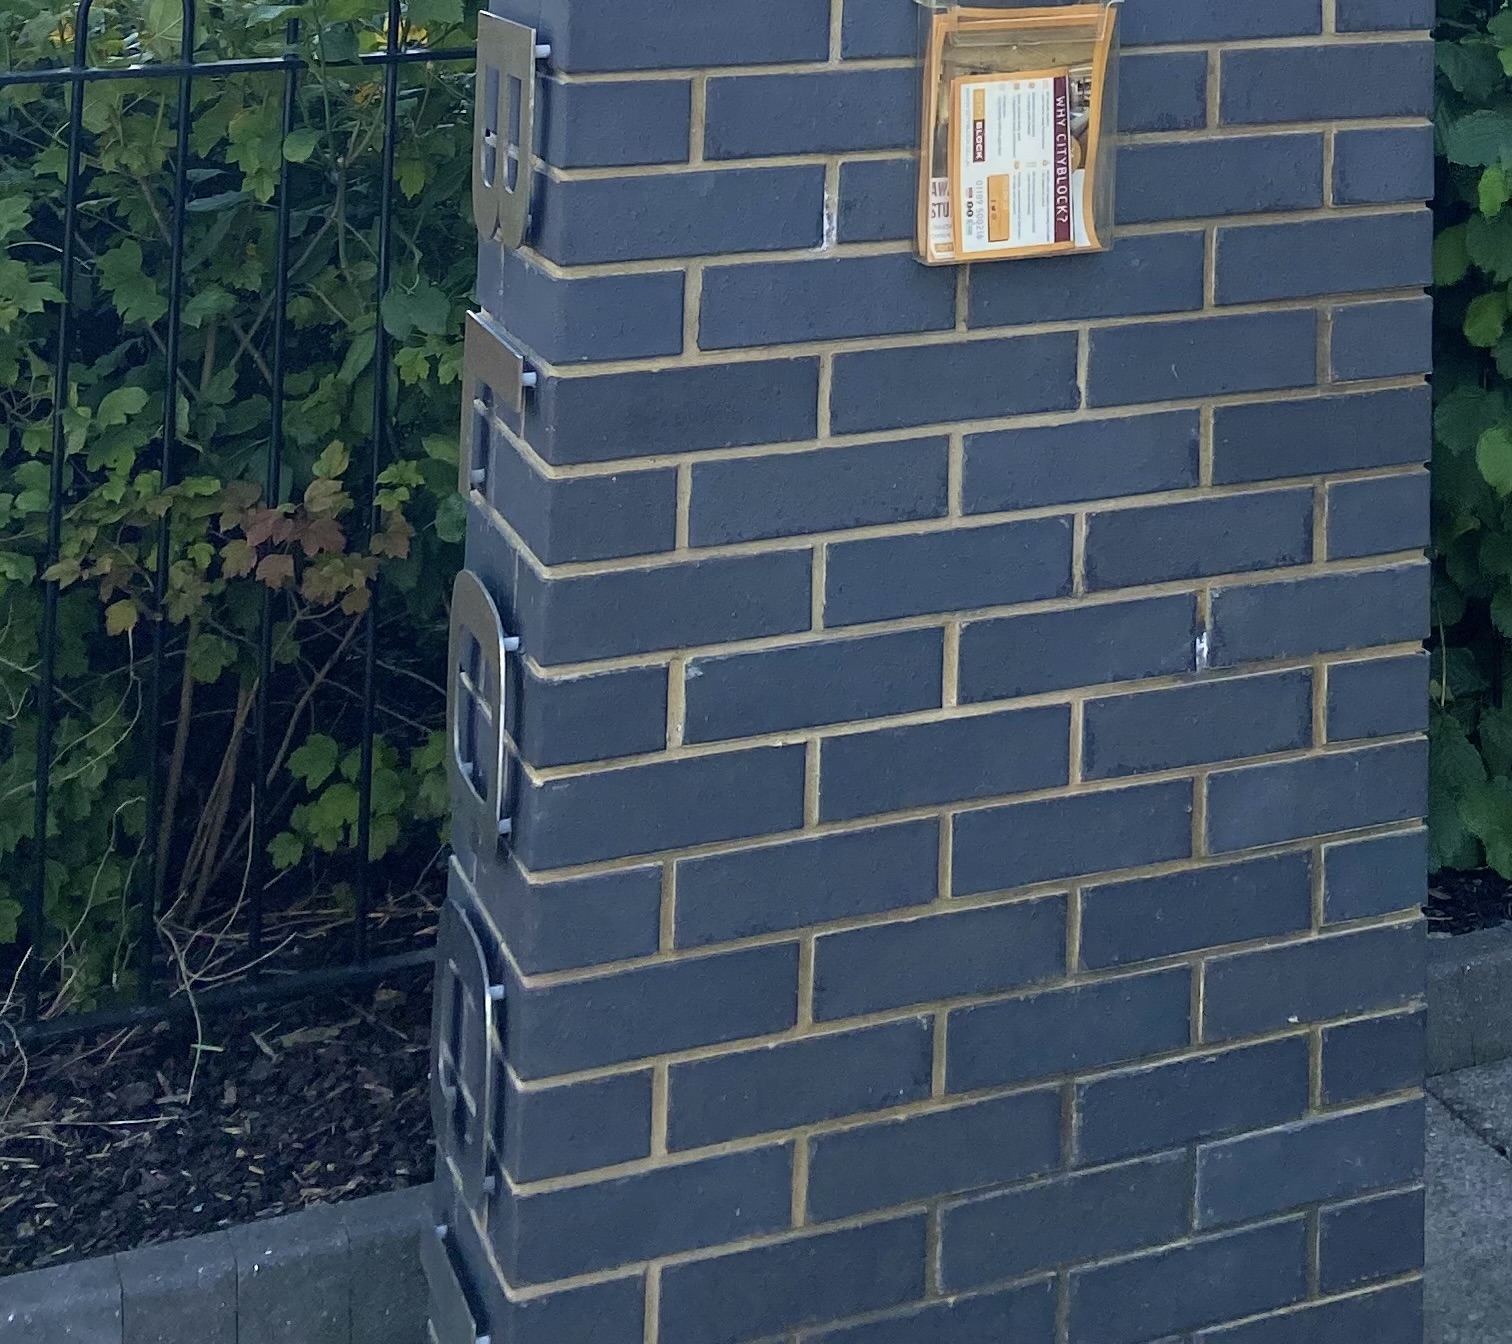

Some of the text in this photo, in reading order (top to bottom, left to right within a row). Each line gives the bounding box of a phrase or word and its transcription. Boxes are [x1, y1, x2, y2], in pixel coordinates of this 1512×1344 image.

[974, 121, 984, 161] BLOCK
[1055, 95, 1069, 224] WHY CITYBLOCK?
[421, 9, 536, 1344] BLOC
